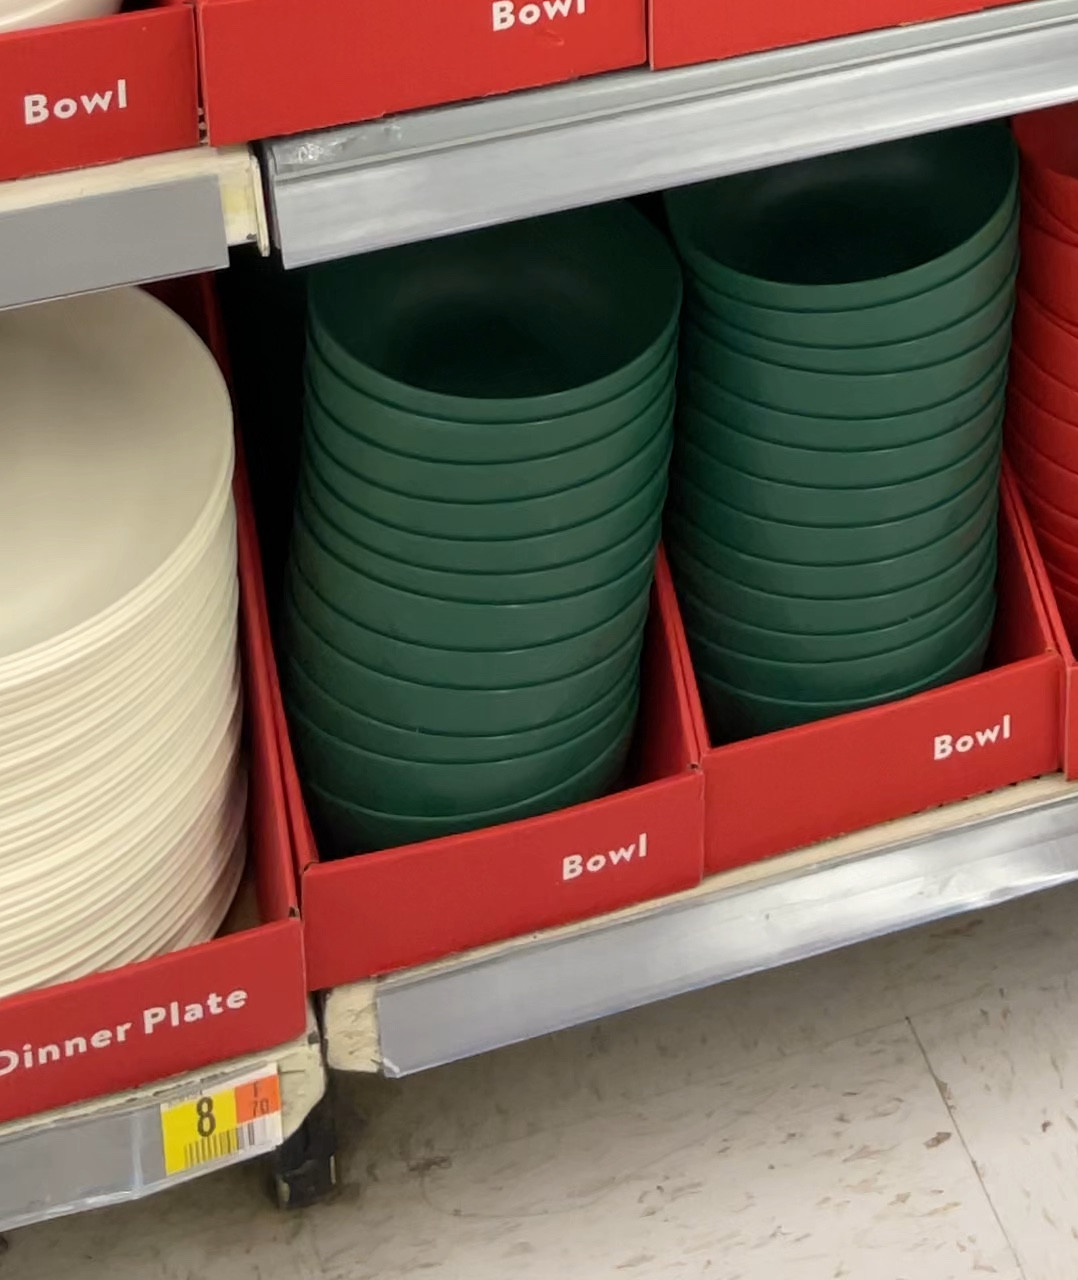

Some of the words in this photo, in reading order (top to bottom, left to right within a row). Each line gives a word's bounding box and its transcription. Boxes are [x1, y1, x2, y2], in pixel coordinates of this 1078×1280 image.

[23, 79, 127, 125] Bowl
[933, 714, 1011, 760] Bowl
[562, 832, 647, 881] Bowl
[143, 990, 248, 1034] Plate
[196, 1096, 217, 1138] 8
